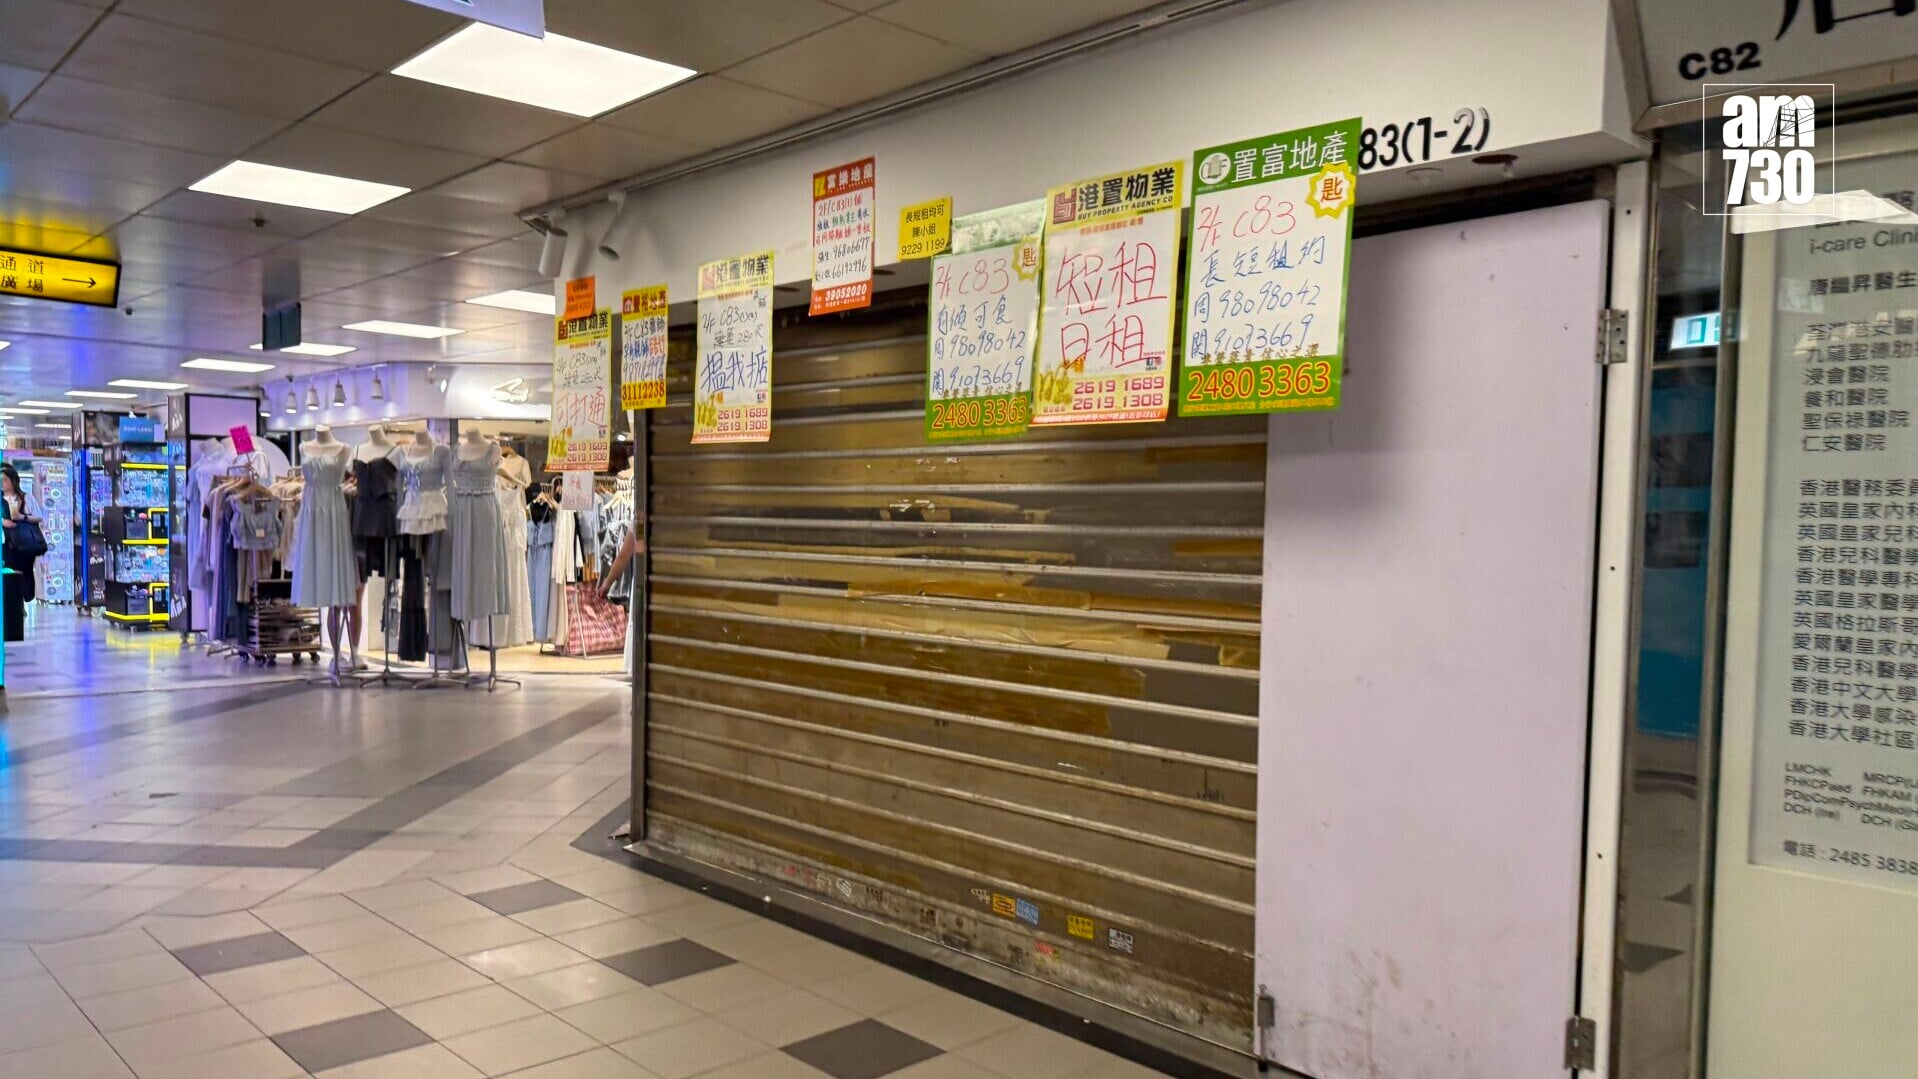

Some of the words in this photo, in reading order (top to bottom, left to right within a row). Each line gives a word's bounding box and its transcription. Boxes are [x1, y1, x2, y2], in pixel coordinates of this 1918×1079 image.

[1679, 42, 1761, 80] C82
[1358, 107, 1490, 170] 83(1-2)
[1231, 130, 1348, 183] 置富地產
[1078, 167, 1175, 211] 港置物業
[1320, 177, 1343, 203] 匙
[1233, 195, 1297, 238] C83
[901, 242, 923, 256] 9229
[925, 237, 946, 252] 1199
[1809, 234, 1866, 254] i-care
[1, 275, 43, 292] 廣場
[1056, 241, 1168, 315] 短租
[825, 282, 868, 302] 39052020
[1074, 380, 1116, 395] 2619
[1124, 376, 1165, 391] 1689
[1187, 366, 1255, 401] 2480
[1258, 361, 1331, 398] 3363
[717, 410, 741, 420] 2619
[745, 407, 768, 418] 1689
[932, 401, 981, 429] 2480
[983, 396, 1027, 425] 3363
[1072, 396, 1114, 410] 2619
[1123, 393, 1163, 408] 1308
[717, 421, 741, 432] 2619
[745, 420, 768, 431] 1308
[1791, 676, 1917, 703] 香港中文大學
[1829, 848, 1870, 867] 2485
